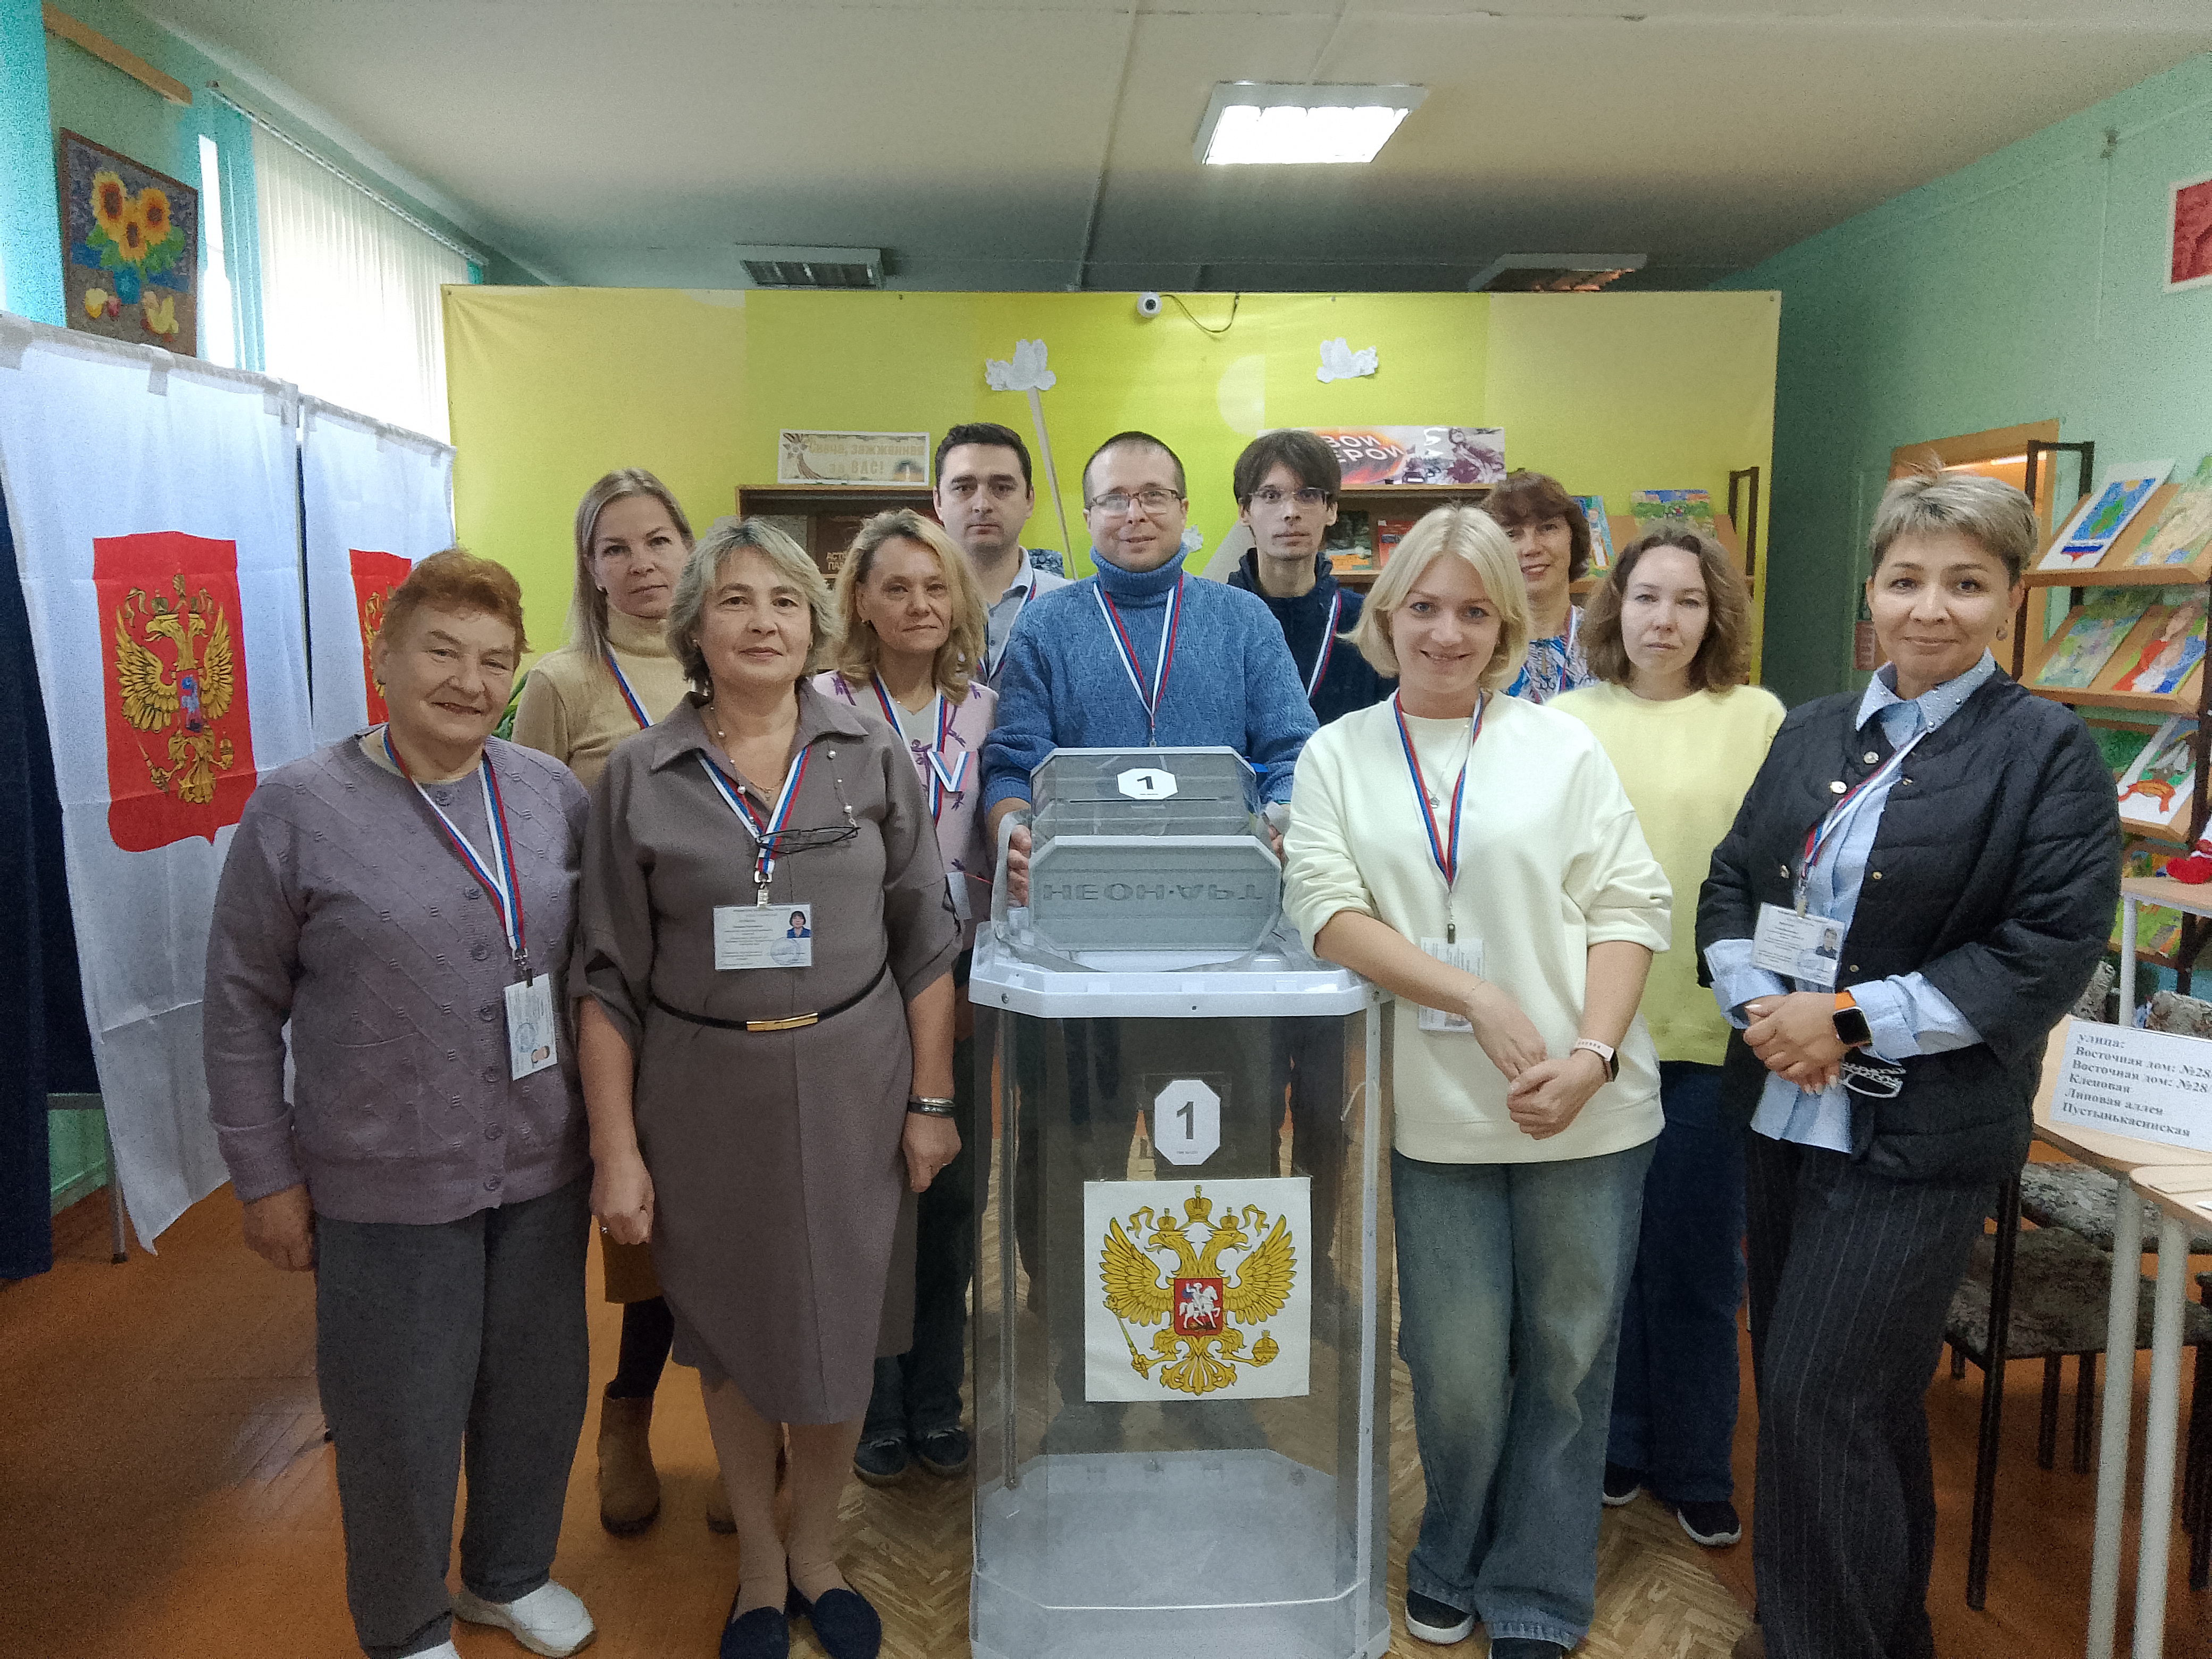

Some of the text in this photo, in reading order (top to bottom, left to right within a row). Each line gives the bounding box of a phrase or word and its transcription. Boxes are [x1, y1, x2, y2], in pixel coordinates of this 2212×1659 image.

[1137, 776, 1154, 790] 1
[2074, 1045, 2143, 1067] Восточная
[2072, 1058, 2139, 1079] Восточная
[1176, 1101, 1194, 1139] 1
